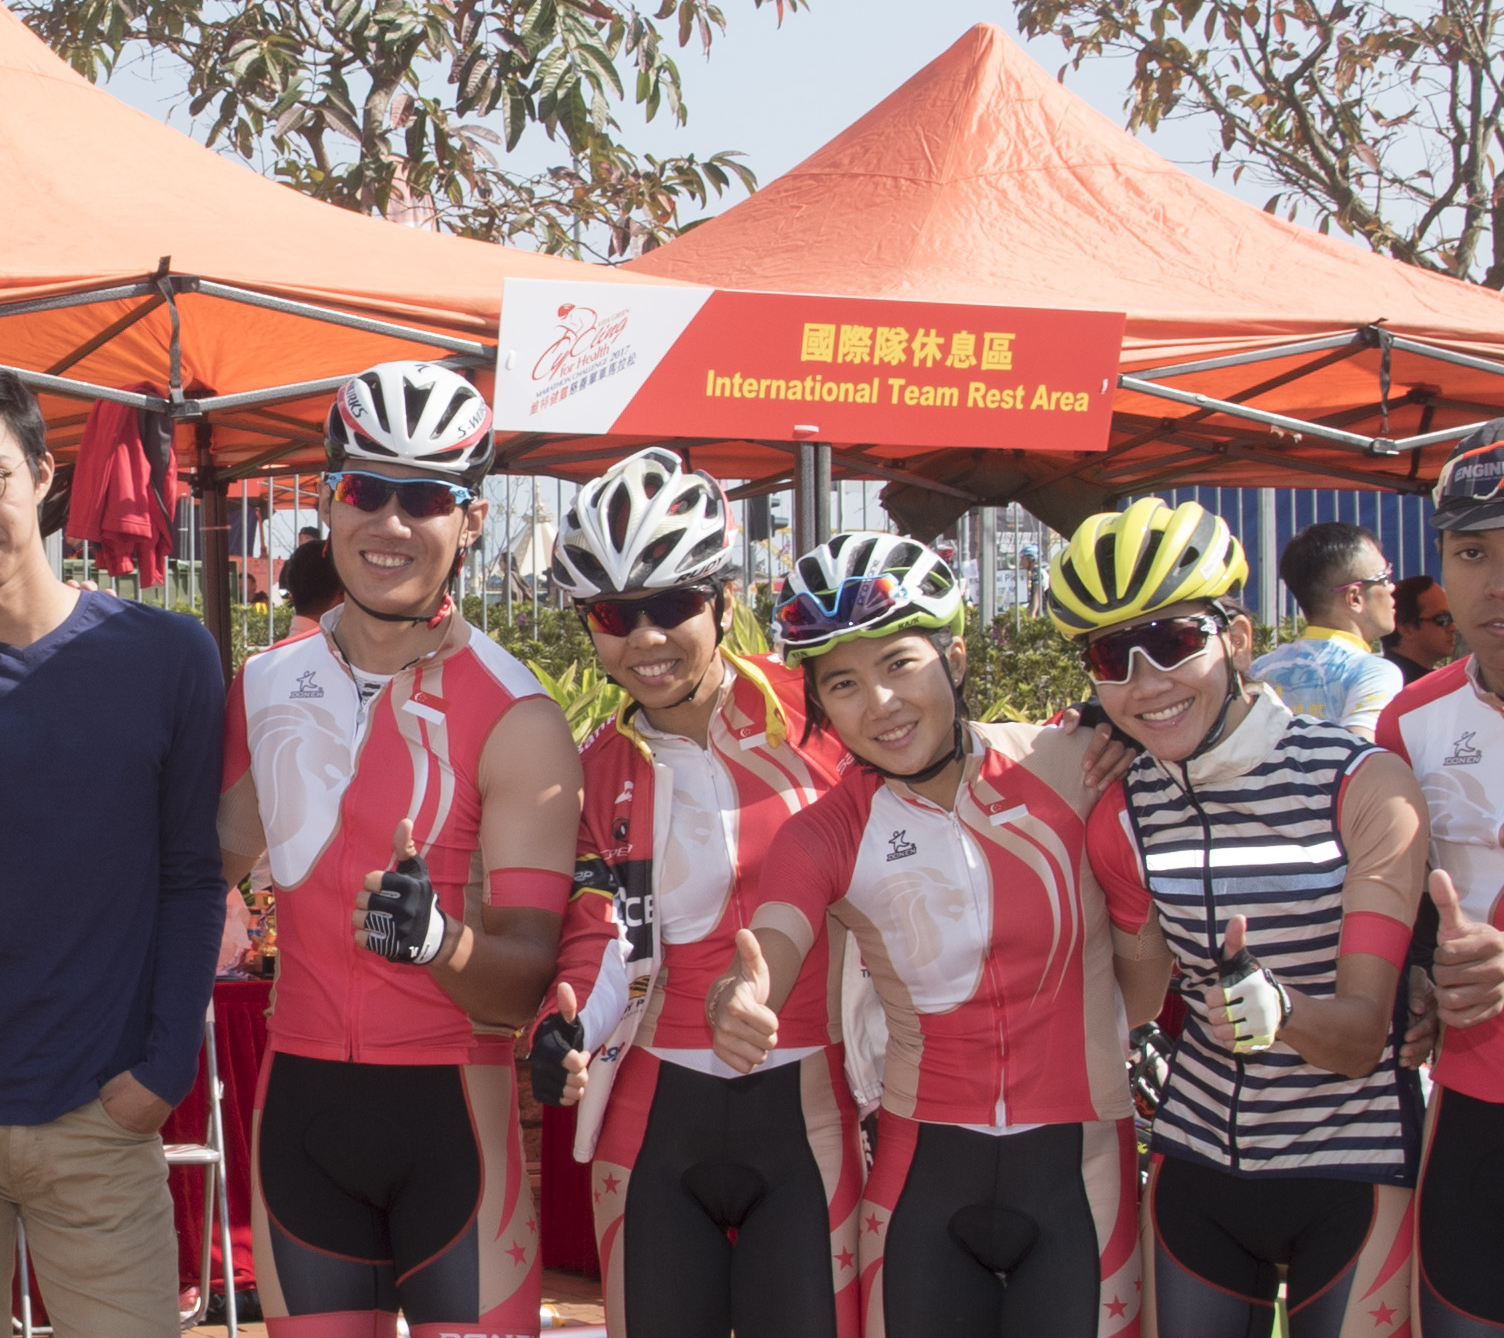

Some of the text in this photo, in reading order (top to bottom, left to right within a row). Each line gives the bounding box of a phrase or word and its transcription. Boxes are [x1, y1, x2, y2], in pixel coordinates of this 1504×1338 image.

[577, 344, 610, 367] Health
[610, 345, 631, 362] 2017
[801, 322, 1016, 370] 國際隊休息區
[706, 369, 1090, 413] International Team Rest Area
